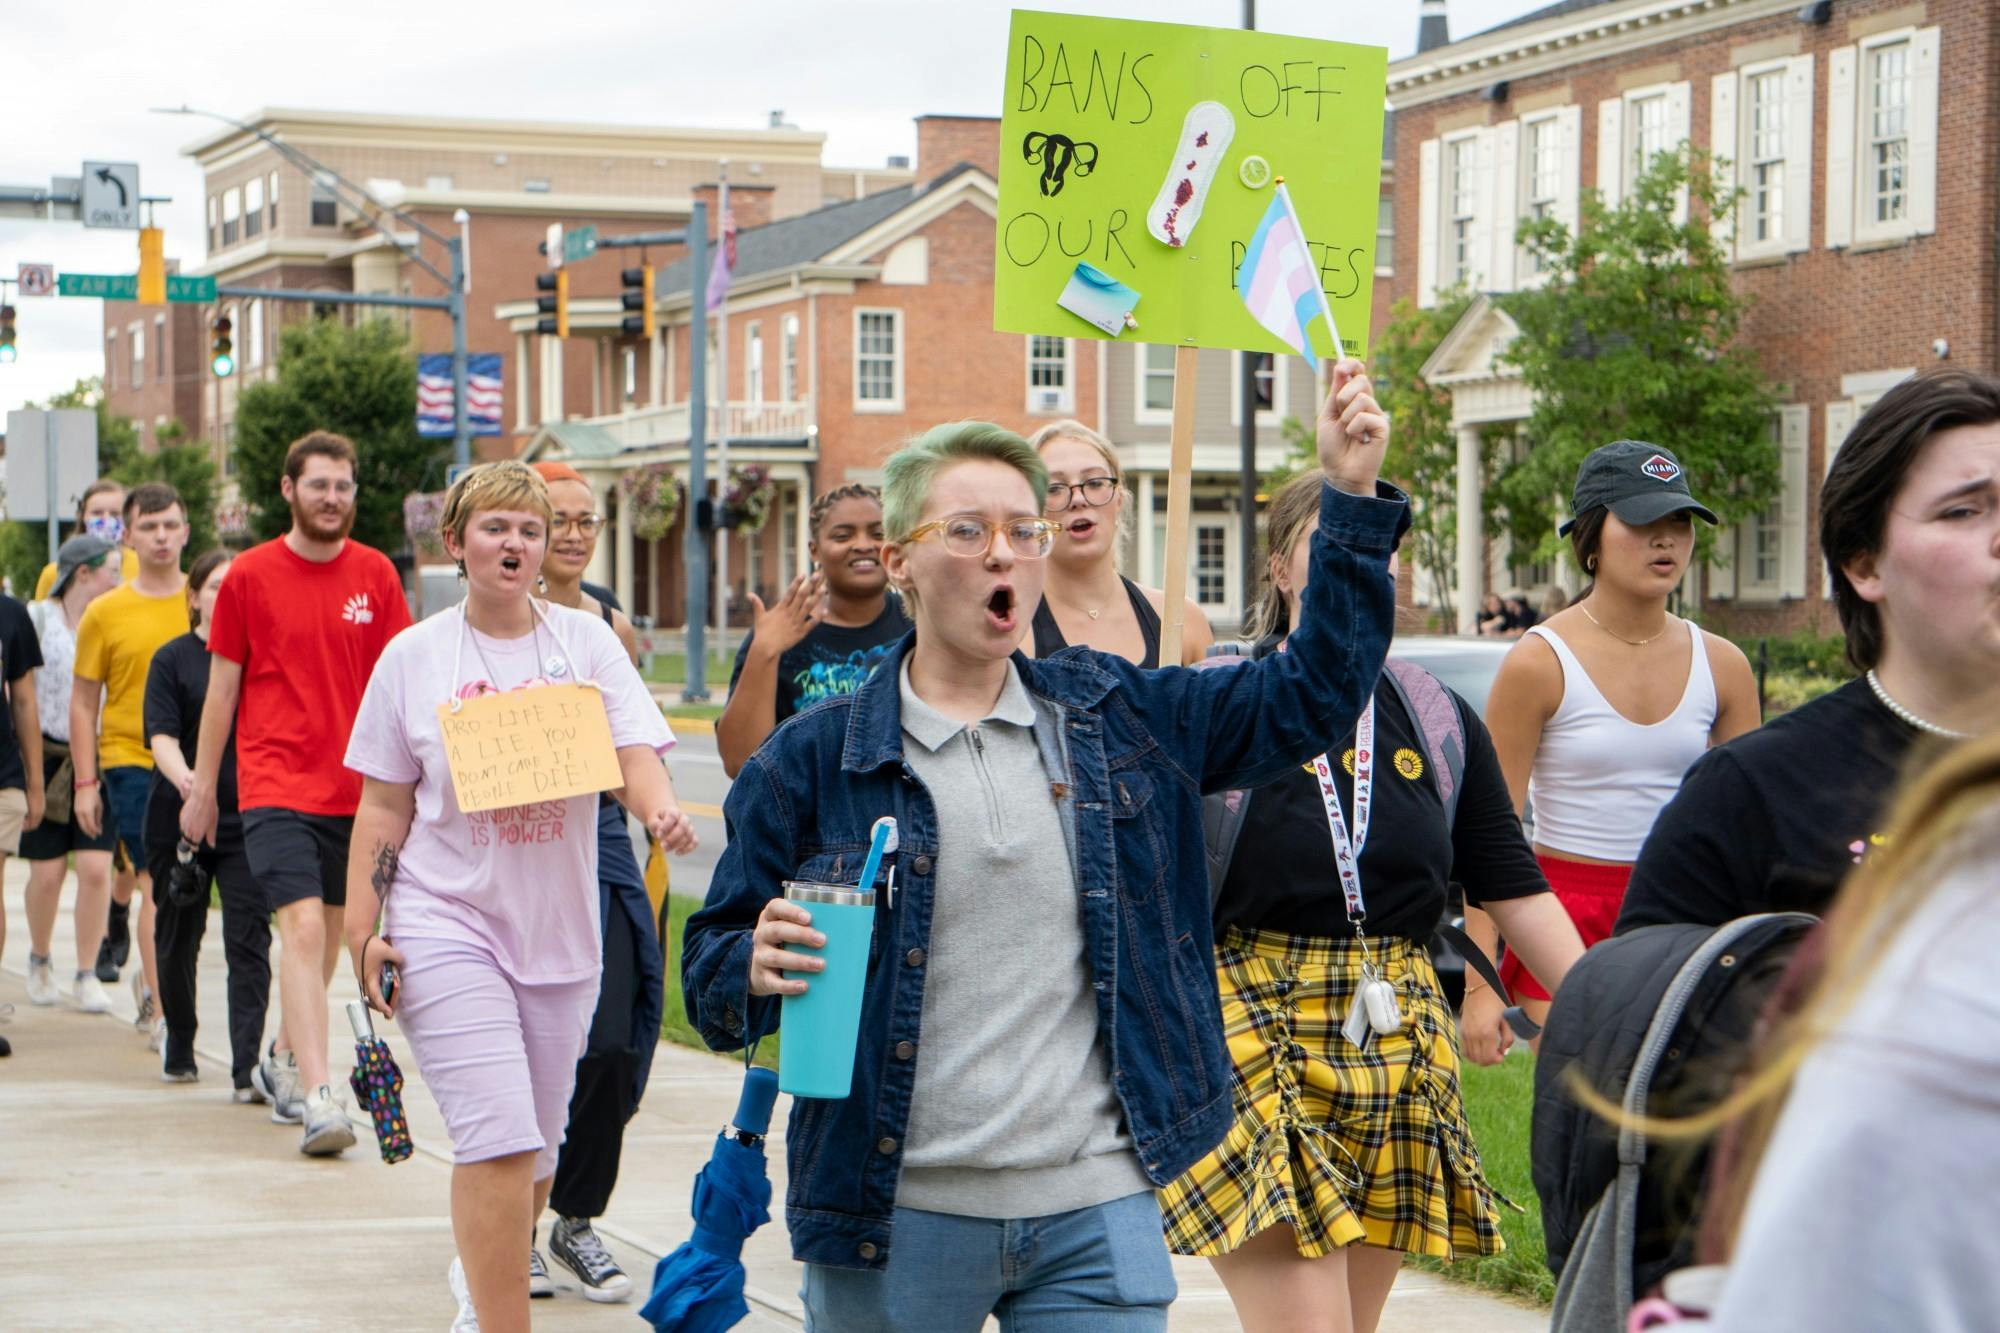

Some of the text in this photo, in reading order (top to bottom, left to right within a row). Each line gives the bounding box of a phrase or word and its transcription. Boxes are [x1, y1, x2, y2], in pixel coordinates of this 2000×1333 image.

[1018, 35, 1346, 125] BANS OFF
[91, 208, 132, 227] ONLY
[1004, 208, 1136, 270] OUR
[65, 276, 207, 298] CAMPU AVE
[1646, 464, 1676, 474] MIAMI
[559, 702, 583, 719] IS
[451, 745, 463, 761] A
[542, 726, 576, 749] YOU
[507, 755, 542, 776] CARE
[552, 747, 572, 765] IF
[462, 759, 590, 808] PEOPLE DIE!
[470, 820, 565, 848] IS POWER
